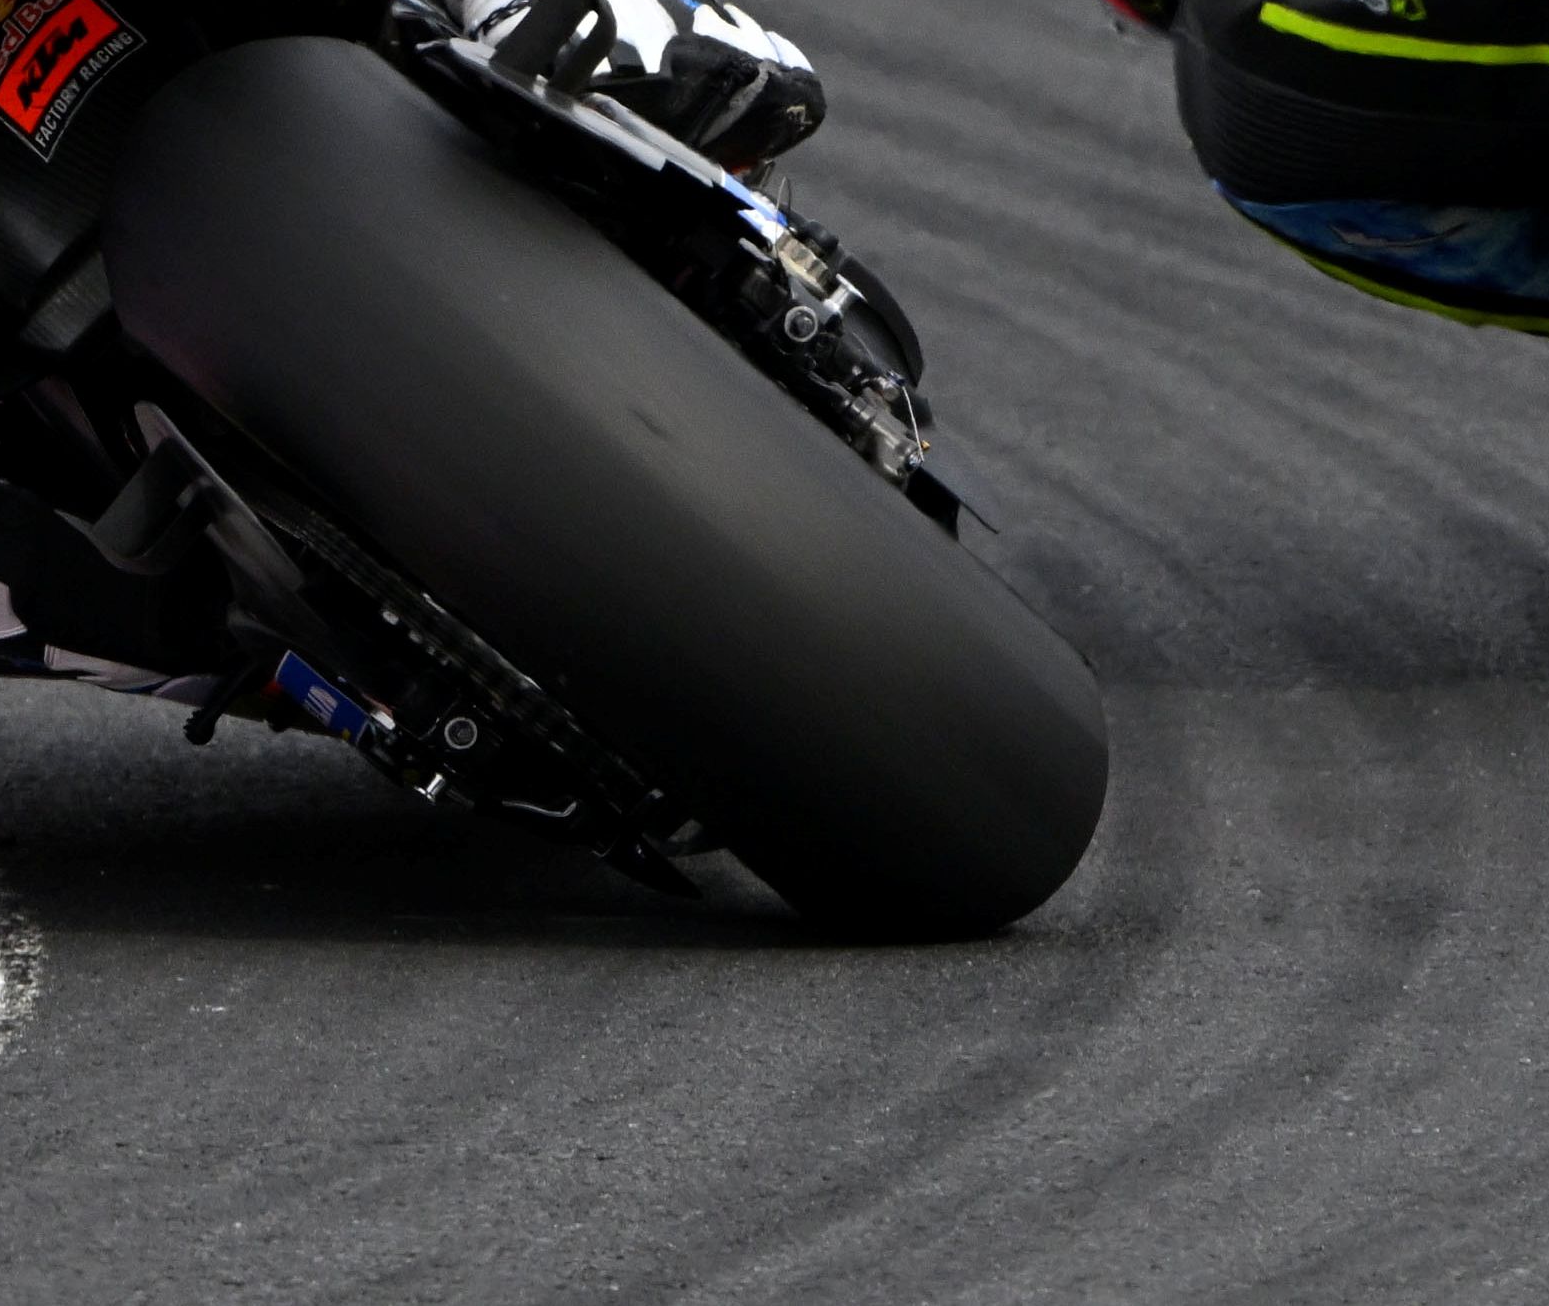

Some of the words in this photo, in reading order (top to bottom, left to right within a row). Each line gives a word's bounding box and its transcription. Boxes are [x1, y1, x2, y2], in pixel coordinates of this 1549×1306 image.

[16, 16, 89, 112] KTM
[35, 79, 82, 148] FACTORY
[79, 31, 134, 81] RACING
